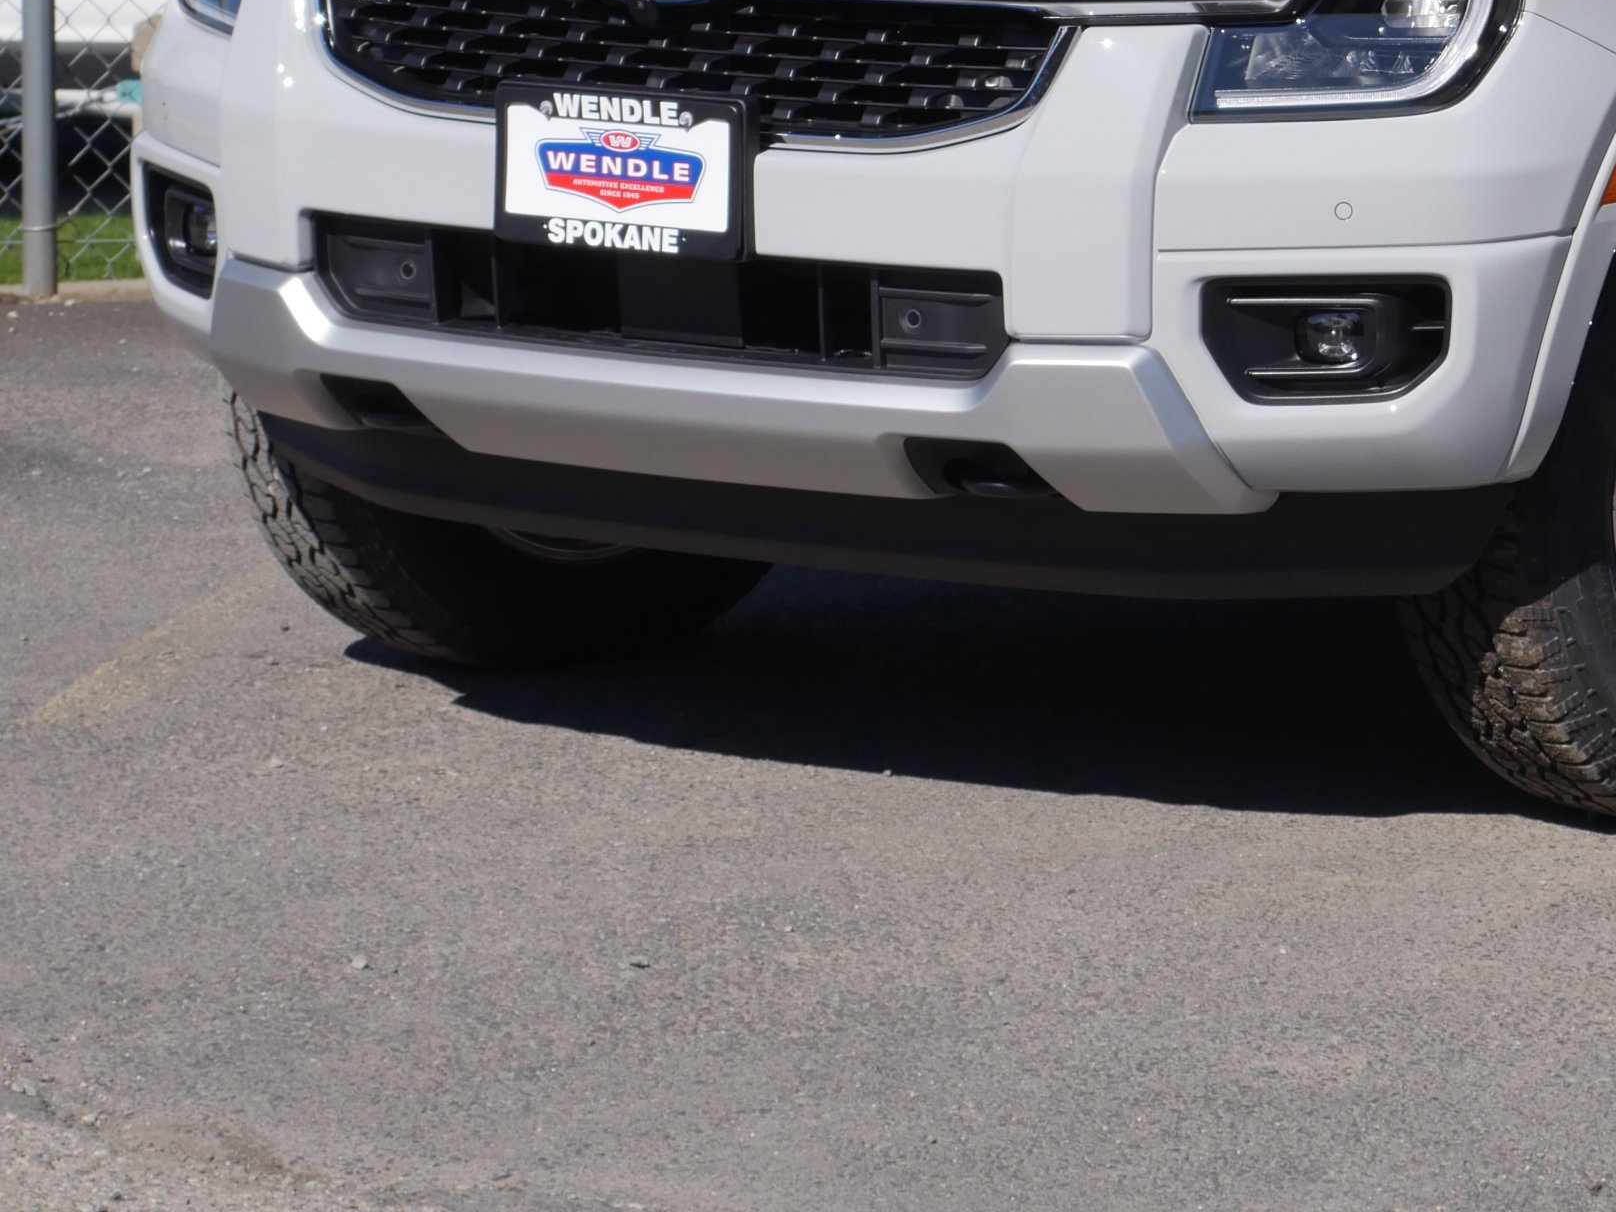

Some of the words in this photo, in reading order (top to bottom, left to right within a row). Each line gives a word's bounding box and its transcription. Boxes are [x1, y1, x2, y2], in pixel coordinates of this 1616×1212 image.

[553, 92, 679, 127] WENDLE
[547, 151, 690, 182] WENDLE
[572, 178, 618, 190] AUTOMOTIVE
[620, 182, 665, 194] EXCELLENCE
[600, 189, 621, 198] SINCE
[623, 191, 640, 199] 1943
[547, 218, 679, 254] SPOKANE
